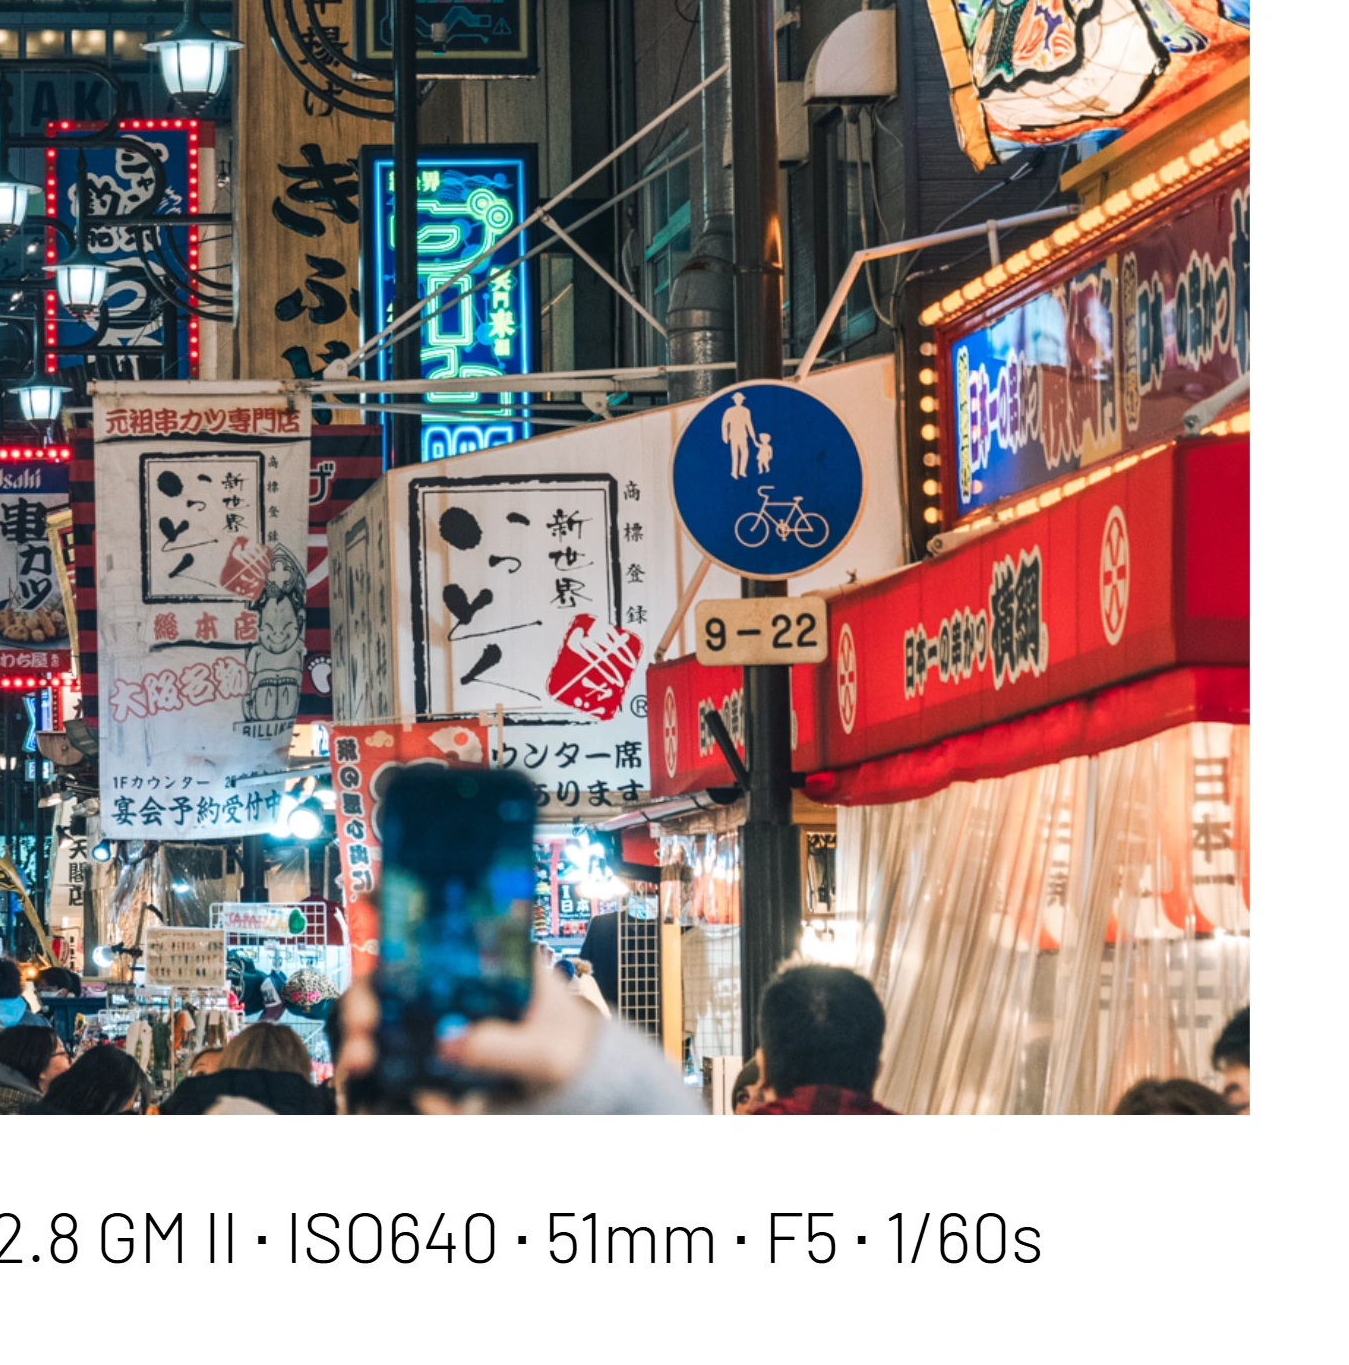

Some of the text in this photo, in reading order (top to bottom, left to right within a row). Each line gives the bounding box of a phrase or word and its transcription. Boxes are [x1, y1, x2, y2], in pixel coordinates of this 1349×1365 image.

[105, 407, 301, 435] 元祖串カツ専門店
[221, 472, 250, 533] 新世界
[0, 497, 53, 611] 串カツ
[546, 508, 594, 610] 新世界
[622, 480, 648, 625] 商標登録
[153, 611, 259, 642] 総本店
[109, 655, 250, 724] 大阪名物
[112, 775, 211, 790] 1Fカウンター
